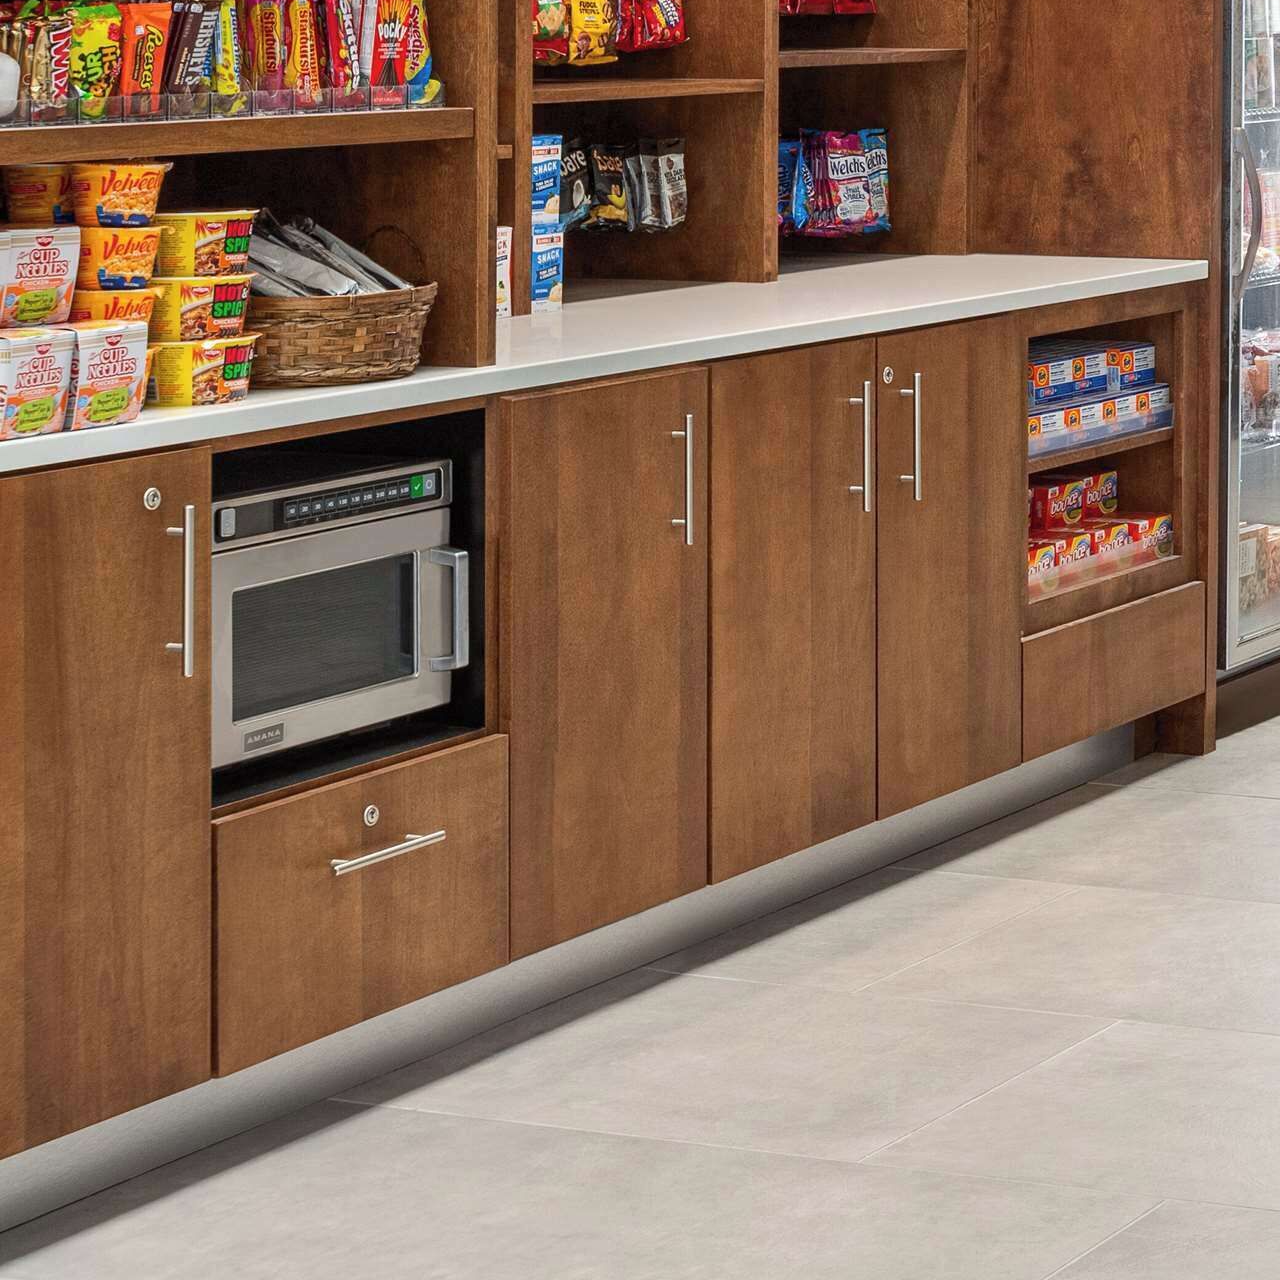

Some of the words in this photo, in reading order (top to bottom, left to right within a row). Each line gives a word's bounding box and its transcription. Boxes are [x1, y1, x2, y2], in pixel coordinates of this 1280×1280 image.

[378, 21, 408, 41] POCKY
[409, 4, 425, 72] Swedish
[533, 161, 557, 175] SNACK
[830, 158, 866, 176] Welch's
[29, 249, 60, 263] CUP
[537, 249, 560, 264] SNACK
[16, 260, 69, 279] NOODLES
[30, 356, 55, 371] CUP
[100, 347, 127, 363] CUP
[87, 358, 137, 380] NOODLES
[15, 368, 62, 389] NOODLES
[1087, 482, 1113, 504] bounce
[1050, 492, 1079, 514] bounce
[247, 729, 281, 744] AMANA
